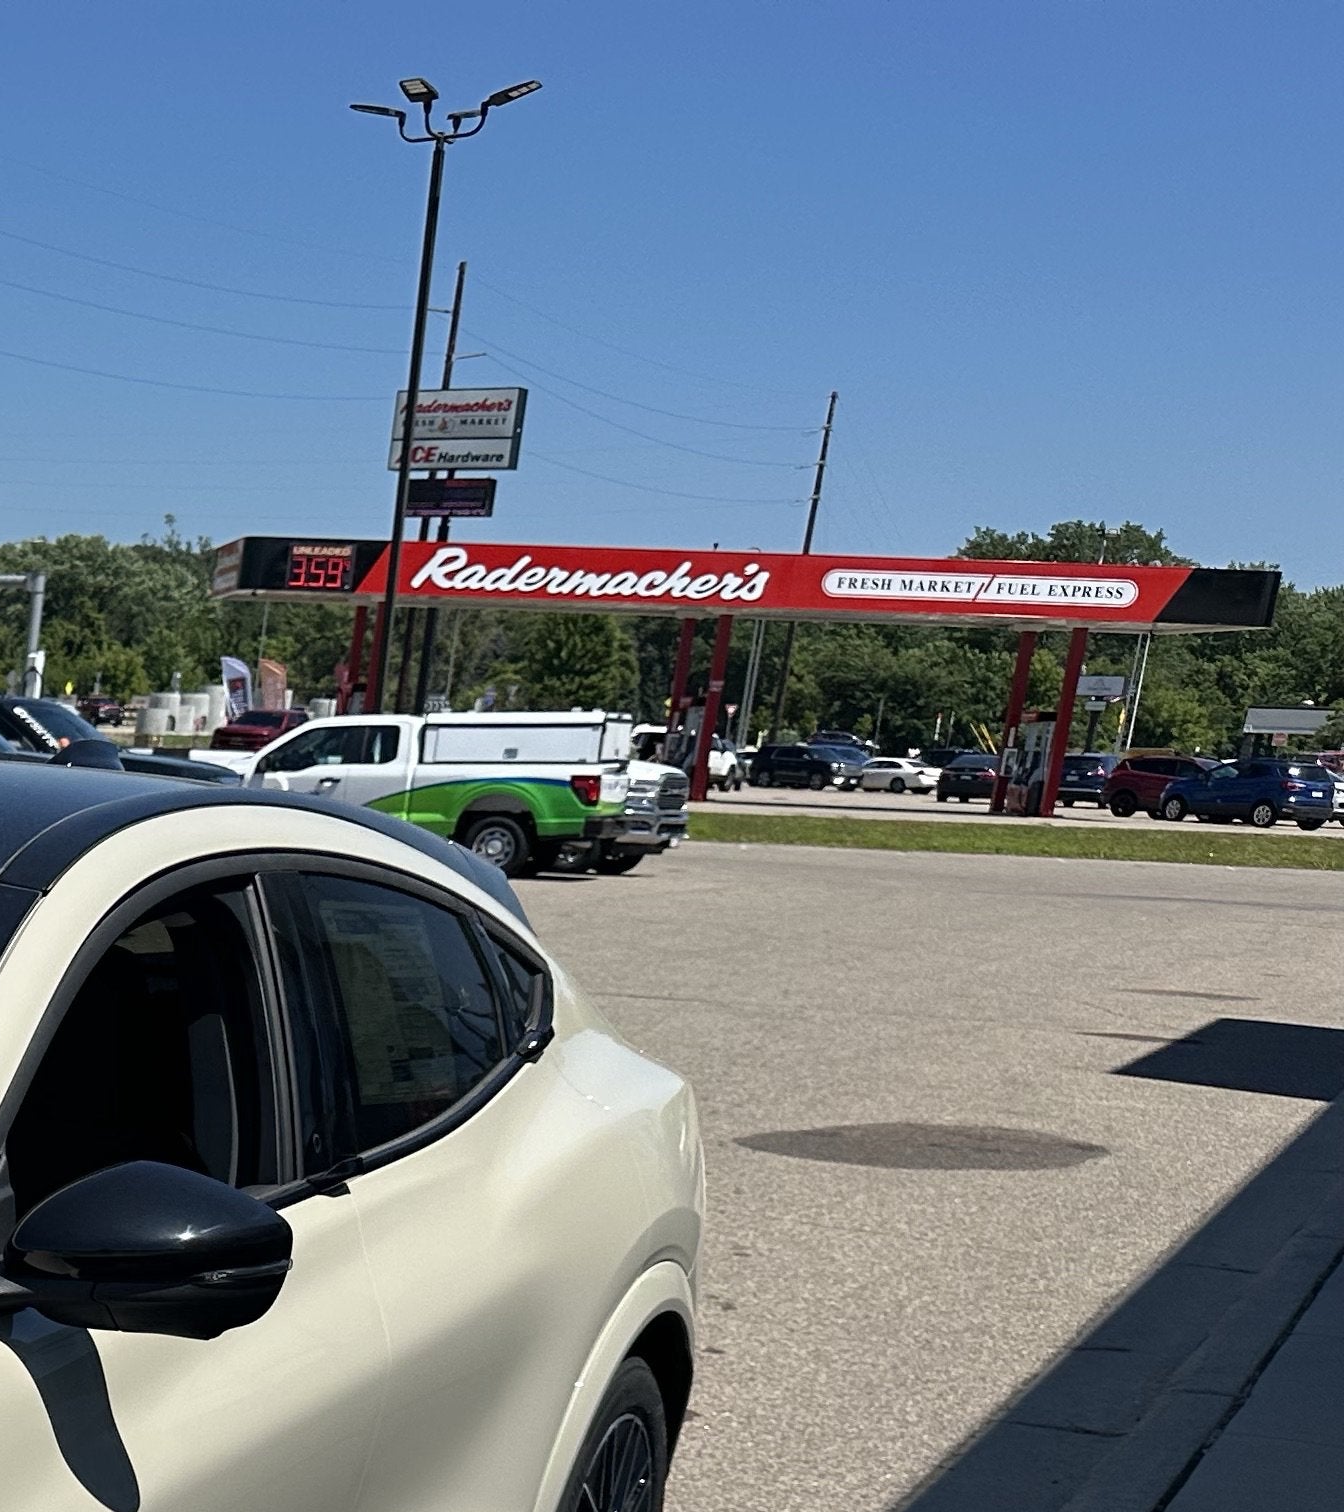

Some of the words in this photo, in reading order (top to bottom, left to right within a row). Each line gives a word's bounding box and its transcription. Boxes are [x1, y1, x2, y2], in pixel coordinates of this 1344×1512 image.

[399, 398, 513, 415] adermacher's
[459, 418, 506, 426] MARKET
[437, 451, 504, 463] Hardware
[292, 545, 353, 556] UNLEADED
[411, 546, 771, 601] Radermacher's
[836, 576, 892, 590] FRESH
[899, 579, 976, 594] MARKET
[995, 582, 1041, 596] FUEL
[1047, 584, 1125, 600] EXPRESS
